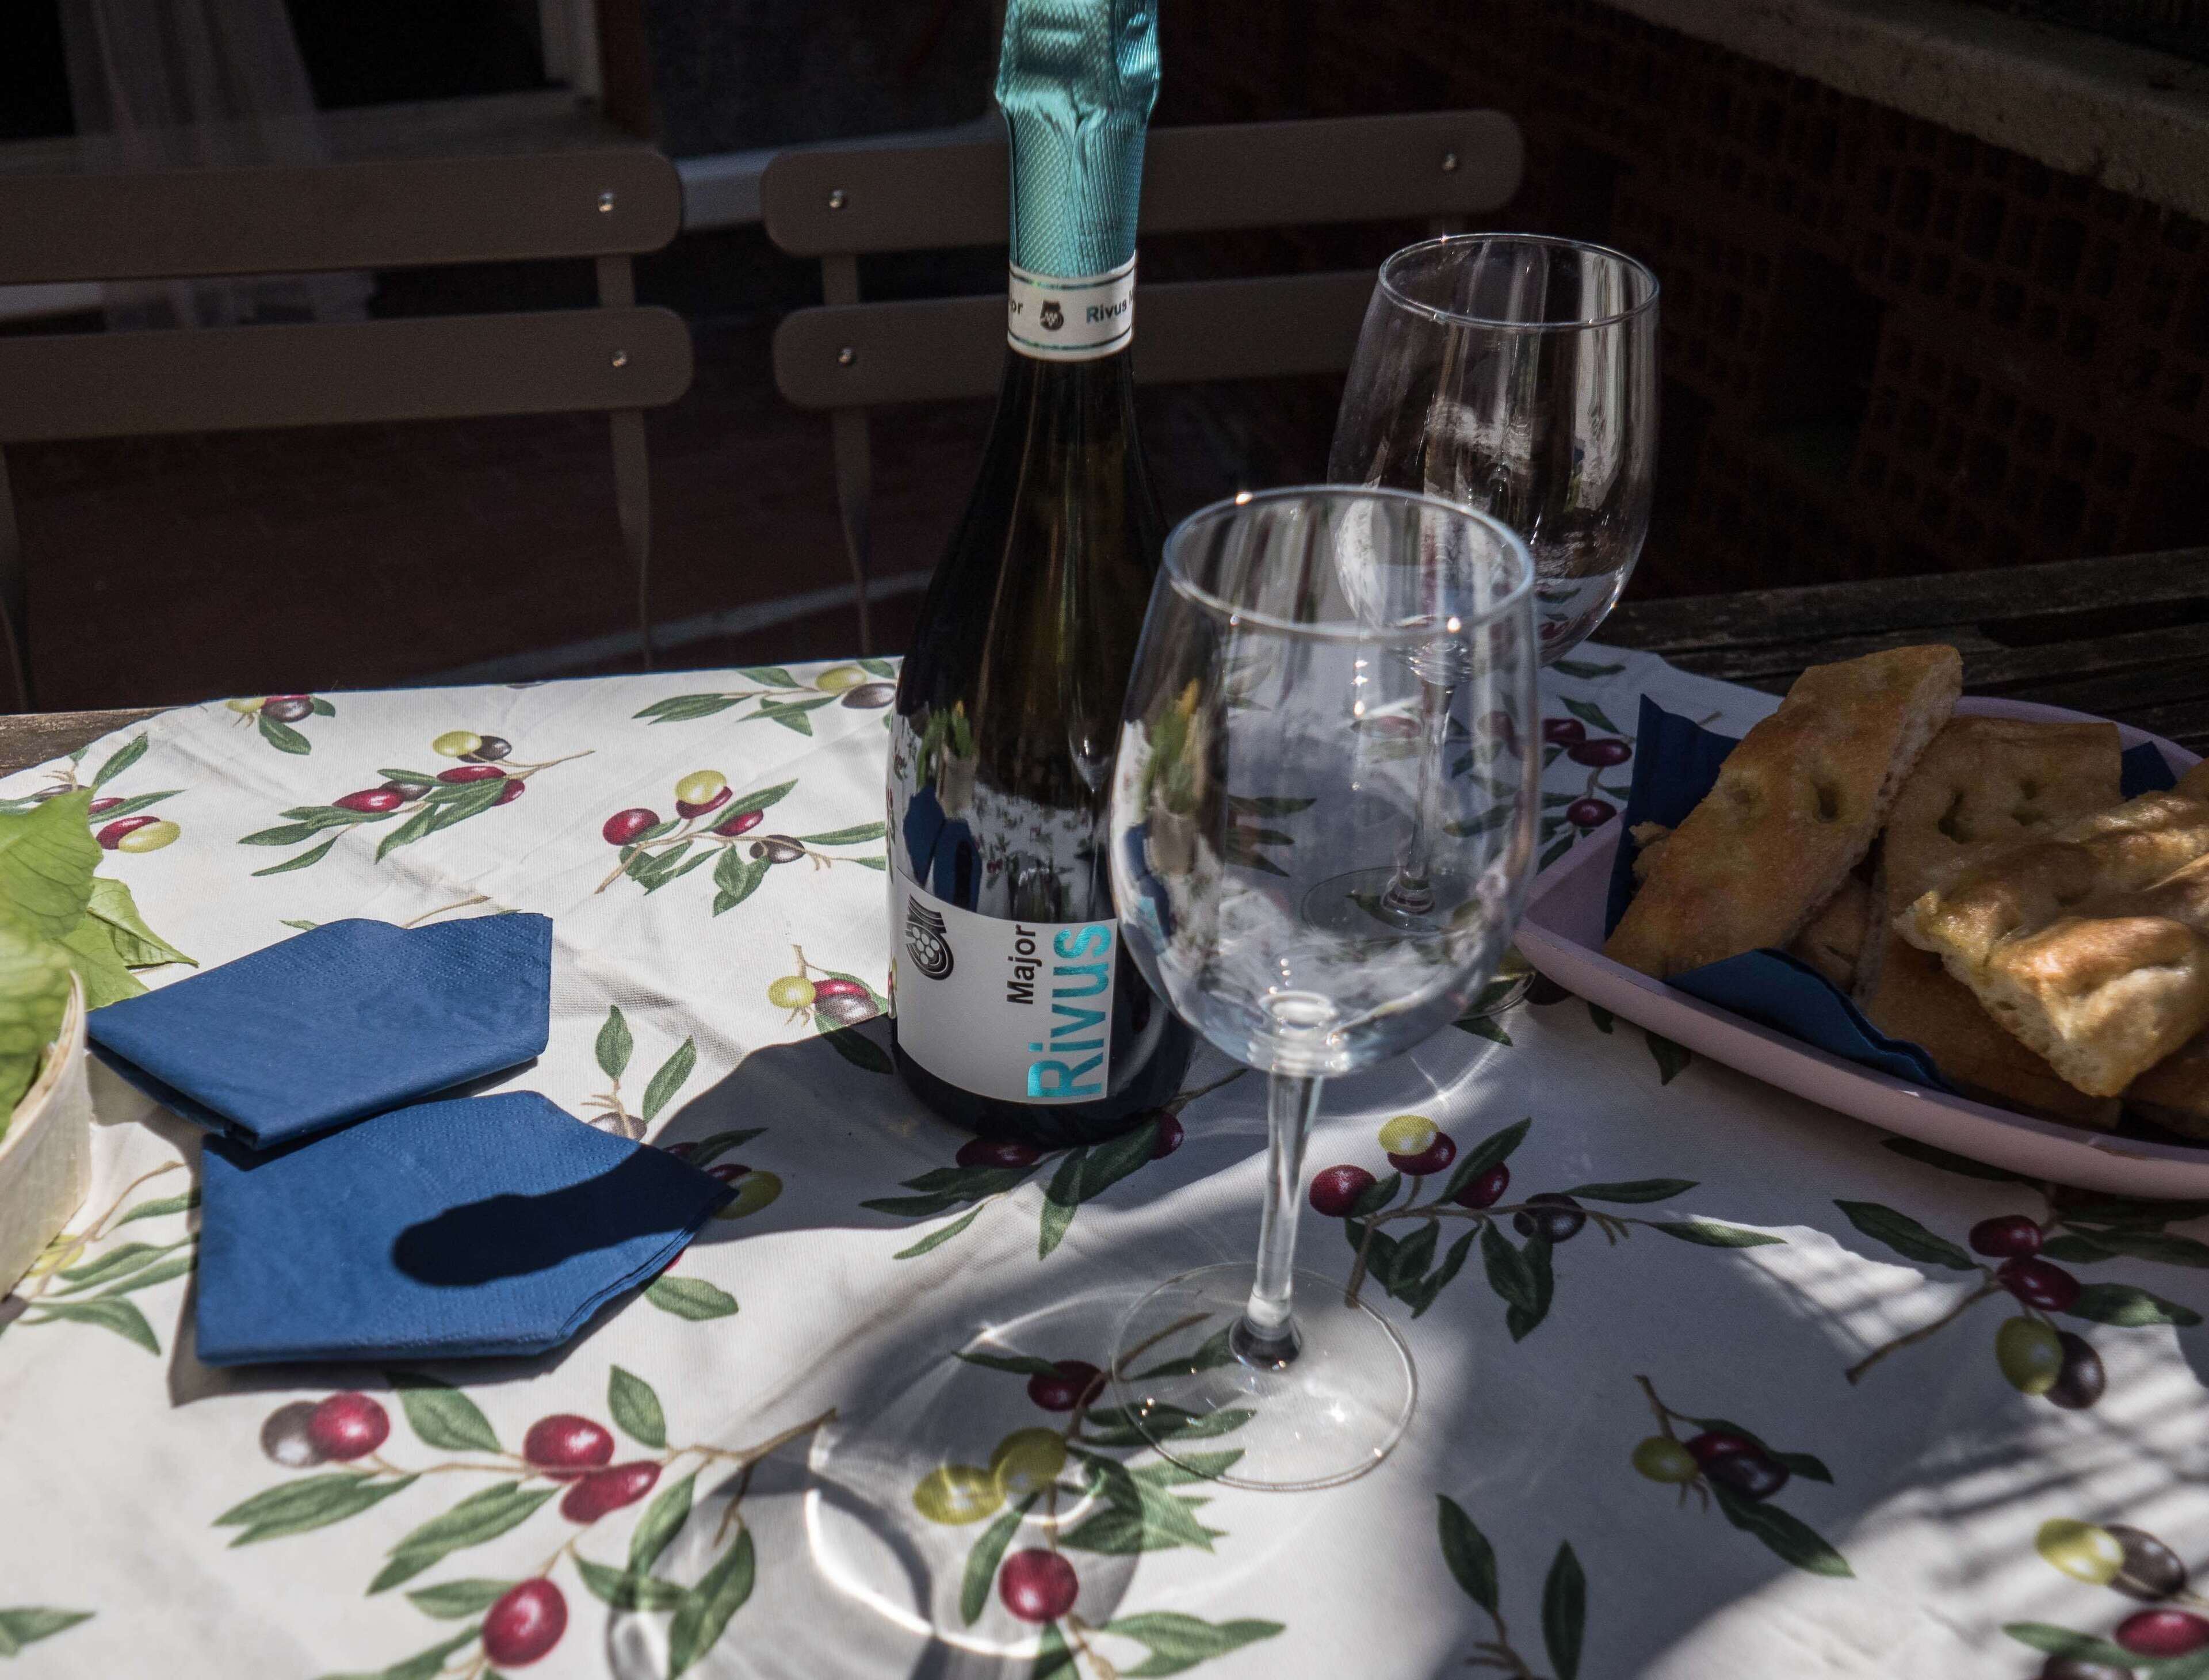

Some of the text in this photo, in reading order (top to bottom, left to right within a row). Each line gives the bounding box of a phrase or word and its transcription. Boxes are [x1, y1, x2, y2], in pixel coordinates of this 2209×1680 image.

[1086, 299, 1127, 324] Rivus
[1007, 924, 1042, 1005] Major
[1027, 924, 1112, 1097] Rivus
